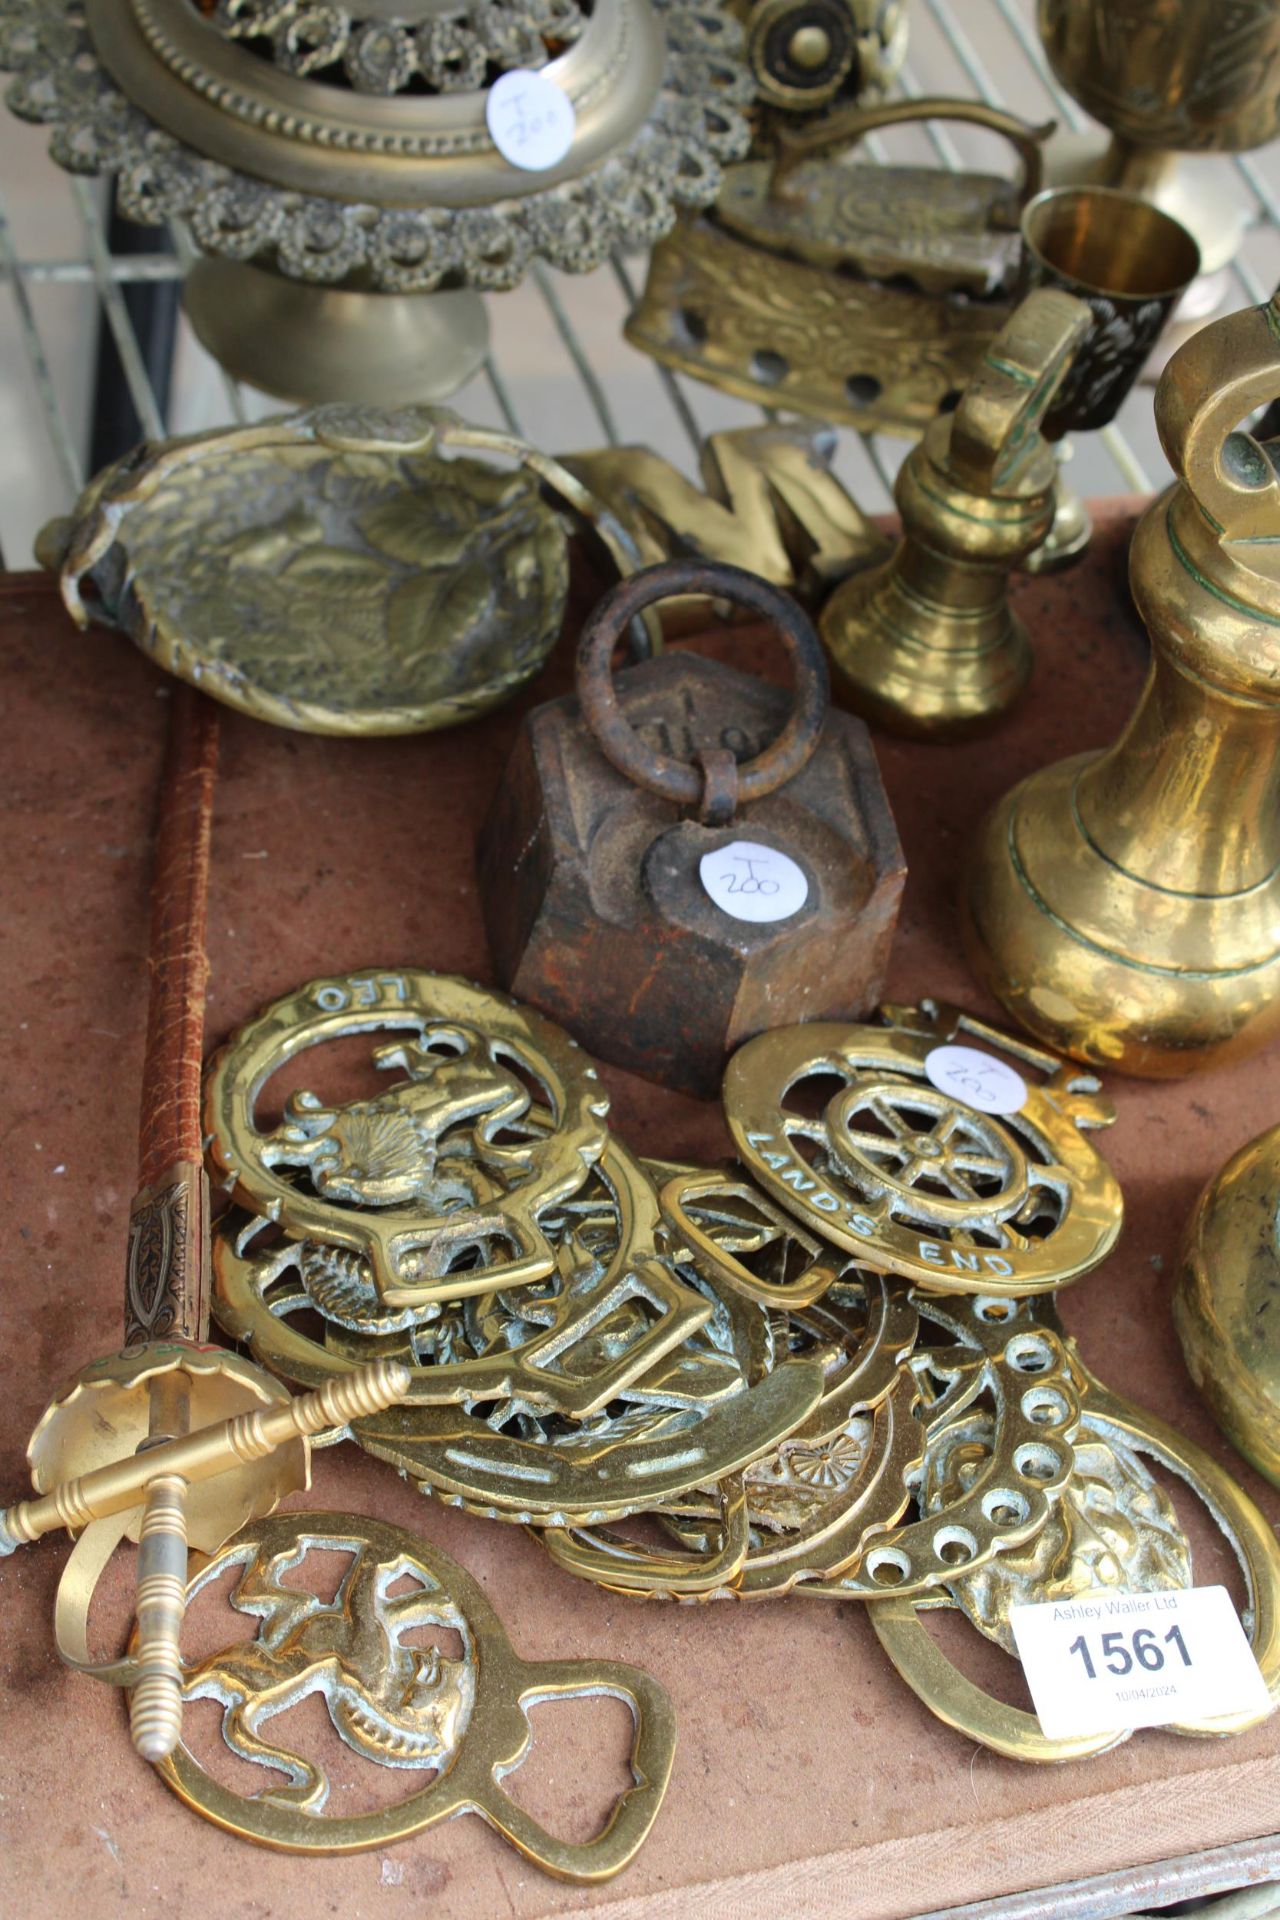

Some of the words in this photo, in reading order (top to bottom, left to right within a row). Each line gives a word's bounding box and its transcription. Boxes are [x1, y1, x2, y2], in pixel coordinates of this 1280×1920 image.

[720, 873, 781, 896] 200
[317, 976, 407, 1012] LEO
[746, 1131, 878, 1237] LAND'S
[918, 1241, 1015, 1277] END
[1053, 1603, 1102, 1622] Ashley
[1105, 1599, 1151, 1615] Waller
[1155, 1596, 1178, 1611] Ltd
[1069, 1624, 1193, 1679] 1561
[1115, 1684, 1178, 1703] 10/04/2024
